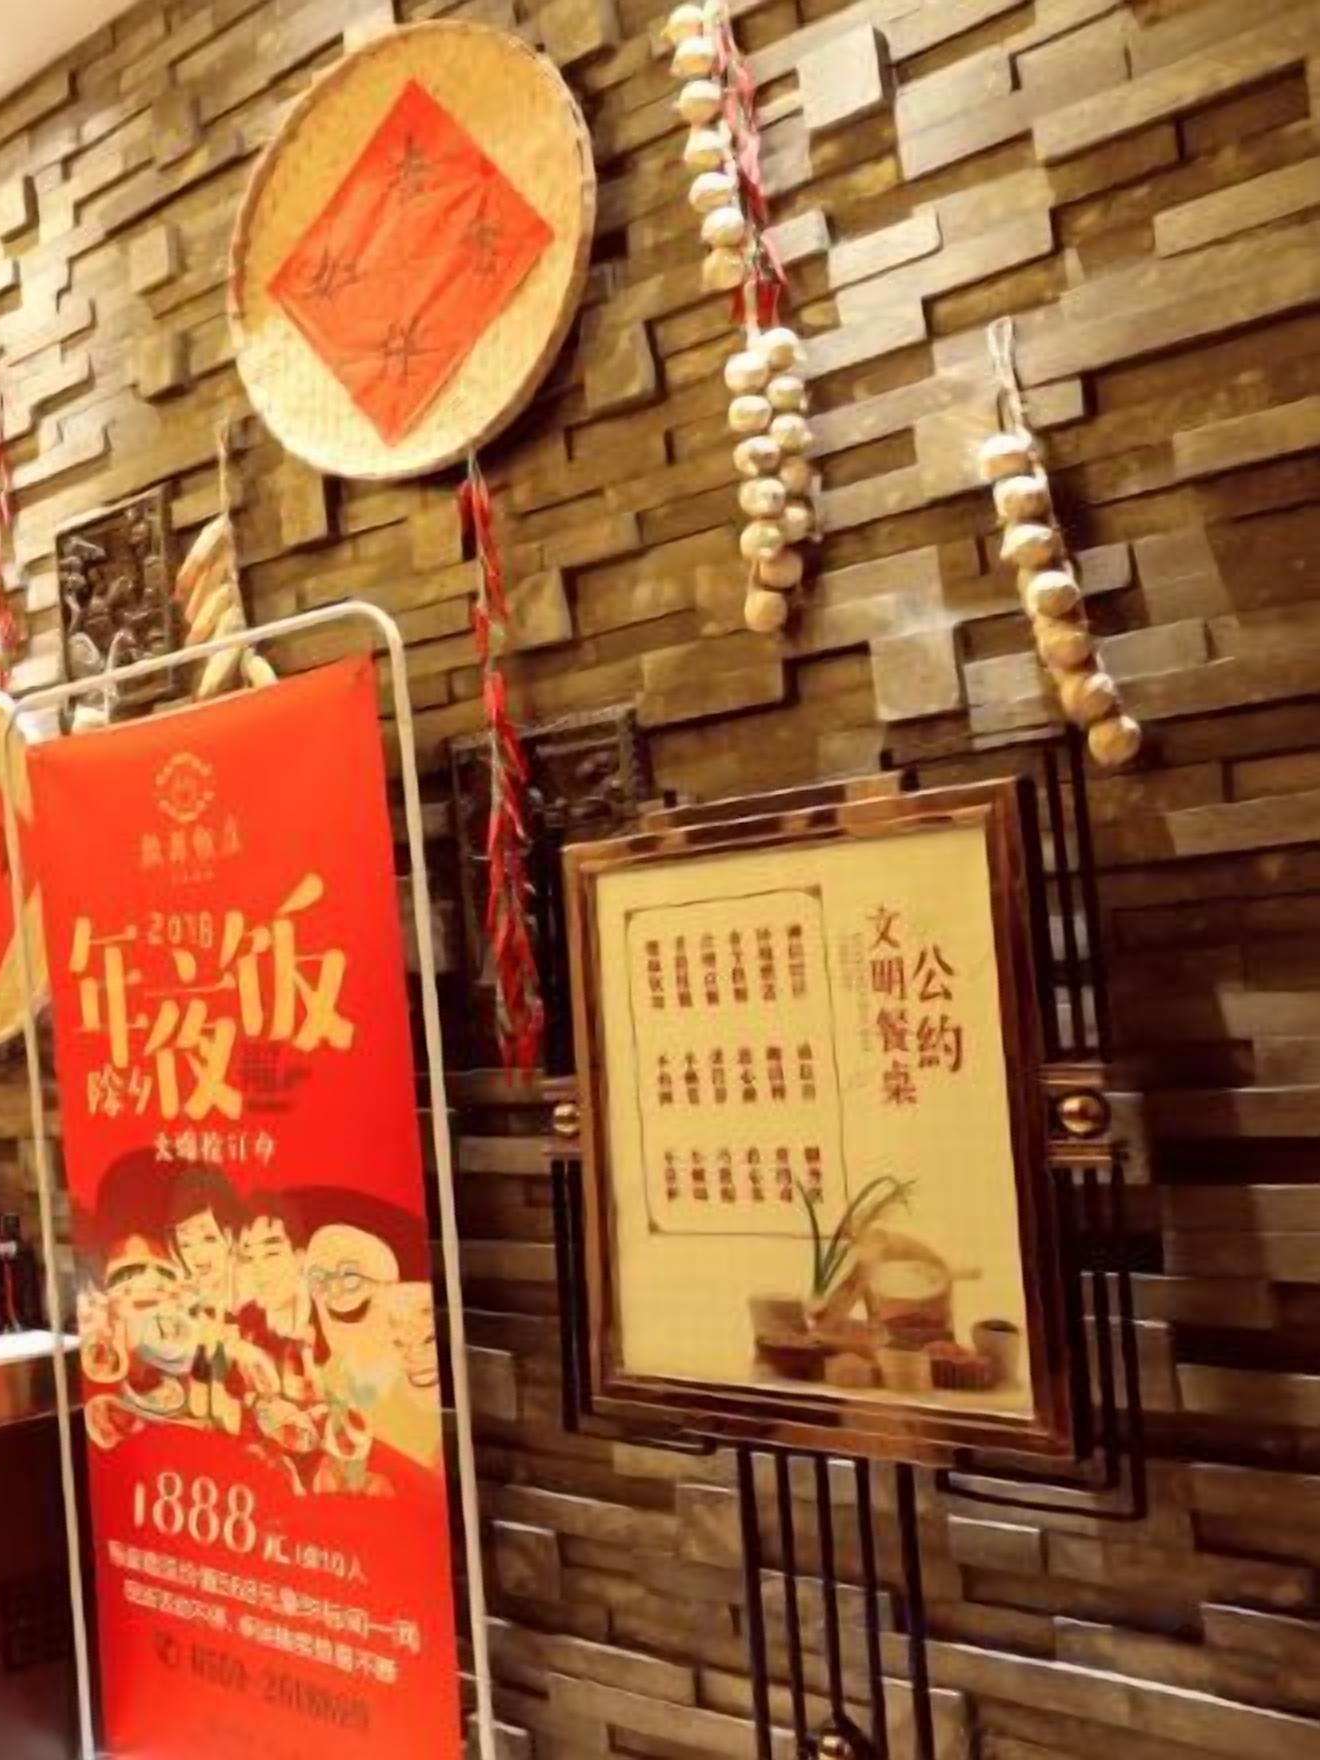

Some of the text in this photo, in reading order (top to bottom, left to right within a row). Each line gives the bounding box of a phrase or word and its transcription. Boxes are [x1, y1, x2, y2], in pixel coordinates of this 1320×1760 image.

[70, 872, 355, 1120] 年夜饭
[146, 910, 214, 948] 2018
